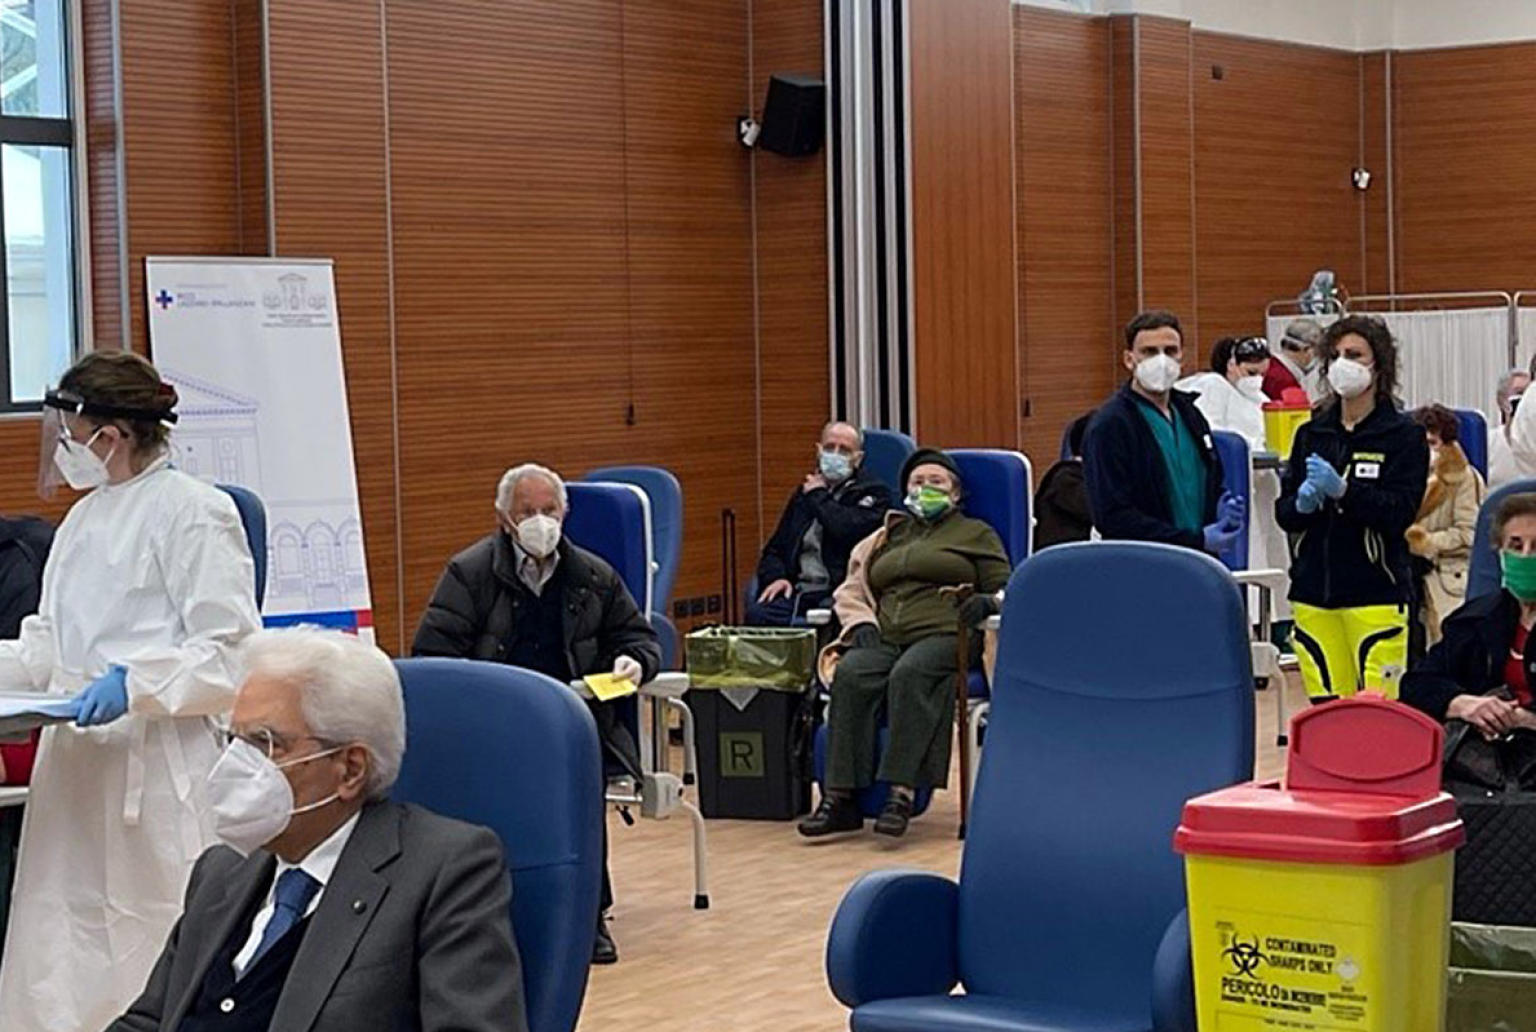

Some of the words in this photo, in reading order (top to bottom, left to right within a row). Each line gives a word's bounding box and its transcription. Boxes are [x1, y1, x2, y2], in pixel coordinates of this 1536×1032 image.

[730, 740, 753, 770] R
[1265, 938, 1335, 957] CONTAMINATED
[1269, 955, 1306, 972] SHARPS
[1308, 959, 1333, 974] ONLY
[1221, 976, 1280, 1000] PERICOLO
